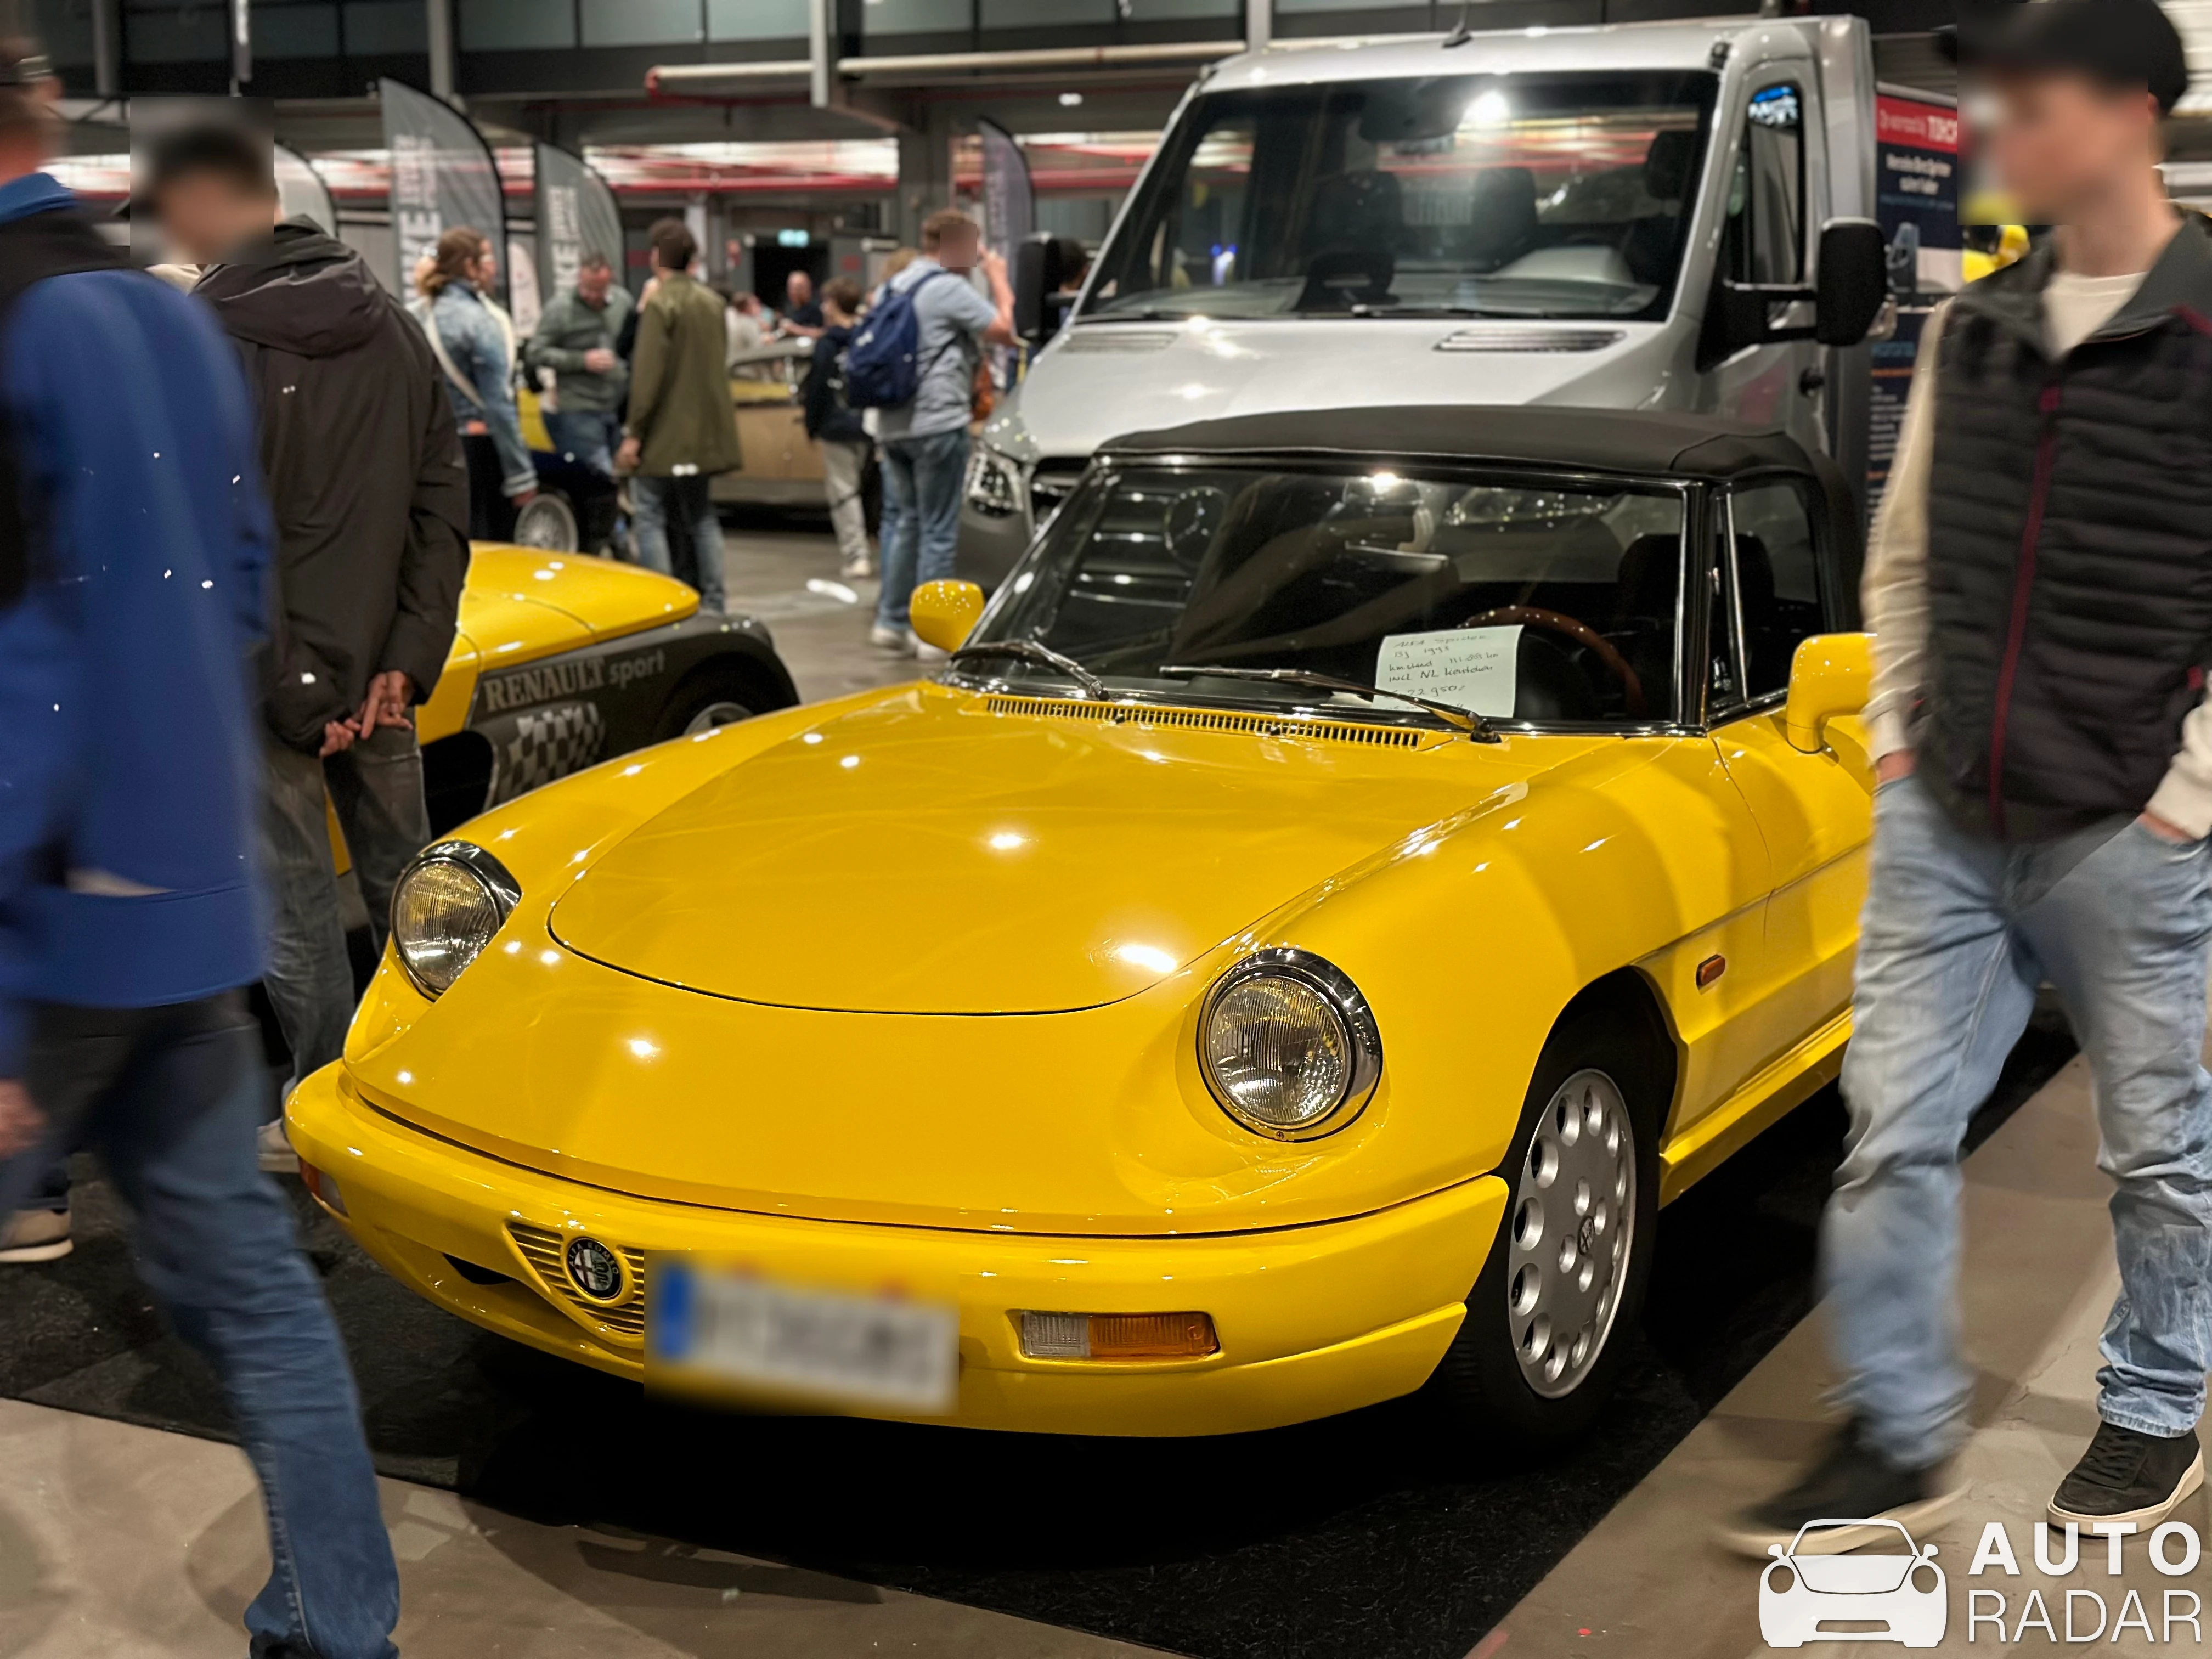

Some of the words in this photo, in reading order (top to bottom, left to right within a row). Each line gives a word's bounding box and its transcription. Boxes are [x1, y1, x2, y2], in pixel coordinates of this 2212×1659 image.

[483, 657, 606, 712] RENAULT
[609, 648, 666, 690] sport
[1420, 669, 1439, 679] NL
[568, 1242, 583, 1267] ALFA
